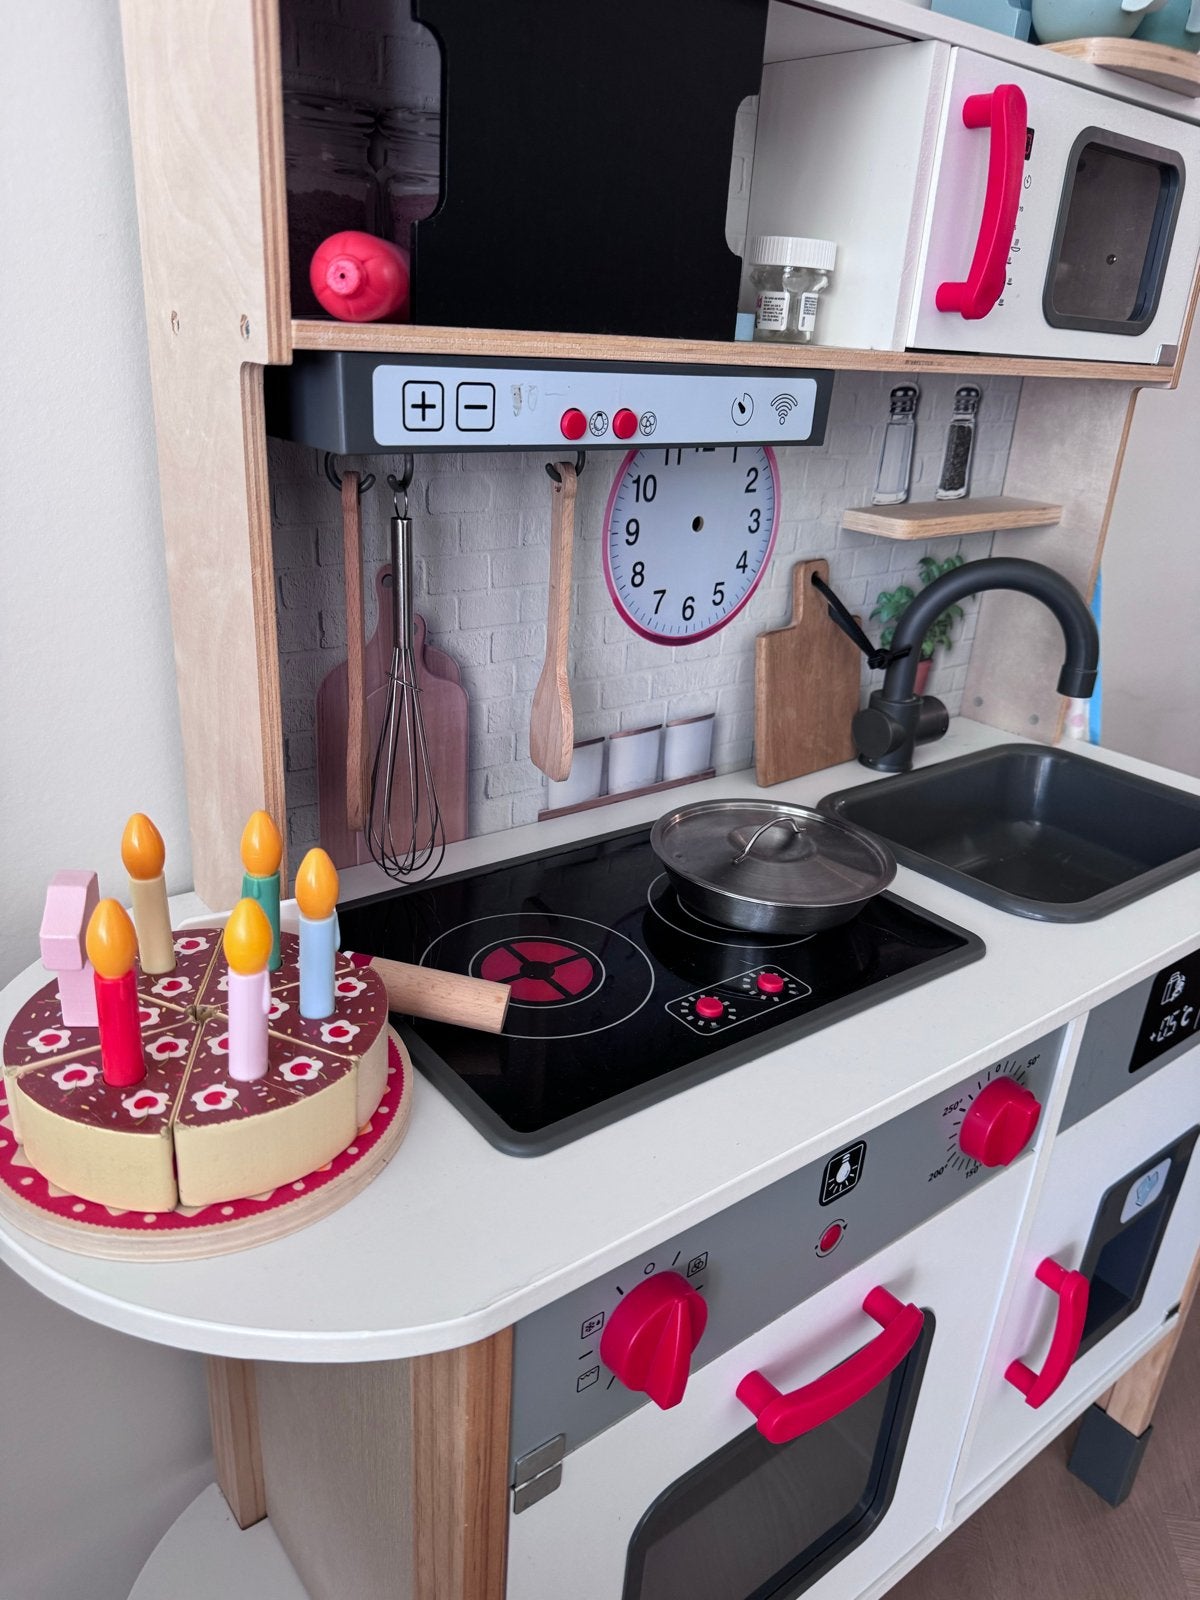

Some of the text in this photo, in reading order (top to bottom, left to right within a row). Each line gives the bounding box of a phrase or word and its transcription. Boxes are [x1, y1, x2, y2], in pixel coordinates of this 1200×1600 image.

[632, 474, 657, 503] 10
[744, 467, 759, 494] 2
[625, 518, 640, 546] 9
[748, 508, 761, 534] 3
[630, 561, 645, 588] 8
[736, 550, 749, 574] 4
[653, 589, 667, 615] 7
[711, 582, 725, 606] 5
[681, 596, 696, 621] 6
[995, 1063, 1002, 1073] 0
